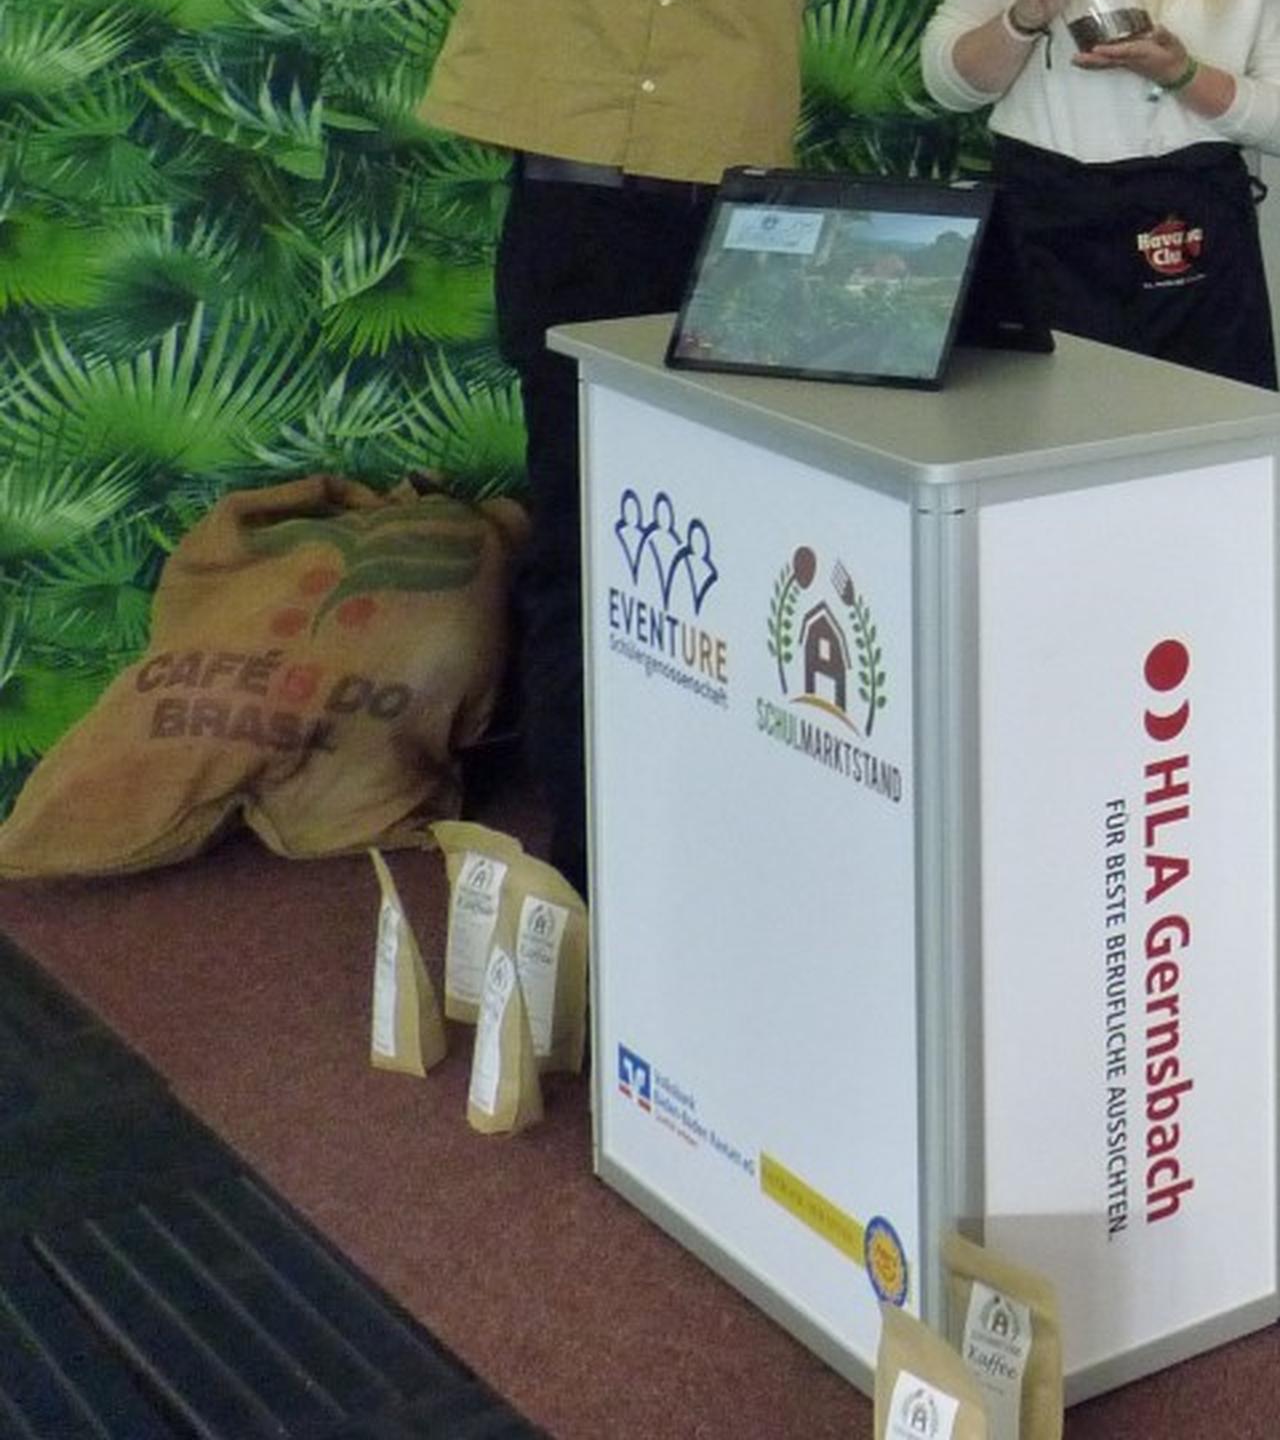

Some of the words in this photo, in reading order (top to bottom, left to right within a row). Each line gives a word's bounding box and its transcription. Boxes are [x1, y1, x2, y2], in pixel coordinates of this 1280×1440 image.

[608, 587, 728, 684] EVENTURE
[756, 697, 902, 803] SCHULMARKTSTAND
[1105, 798, 1129, 847] FÜR
[1144, 754, 1190, 904] HLA
[1105, 852, 1127, 928] BESTE
[1105, 933, 1128, 1081] BERUFLICHE
[1144, 914, 1194, 1224] Gernsbach
